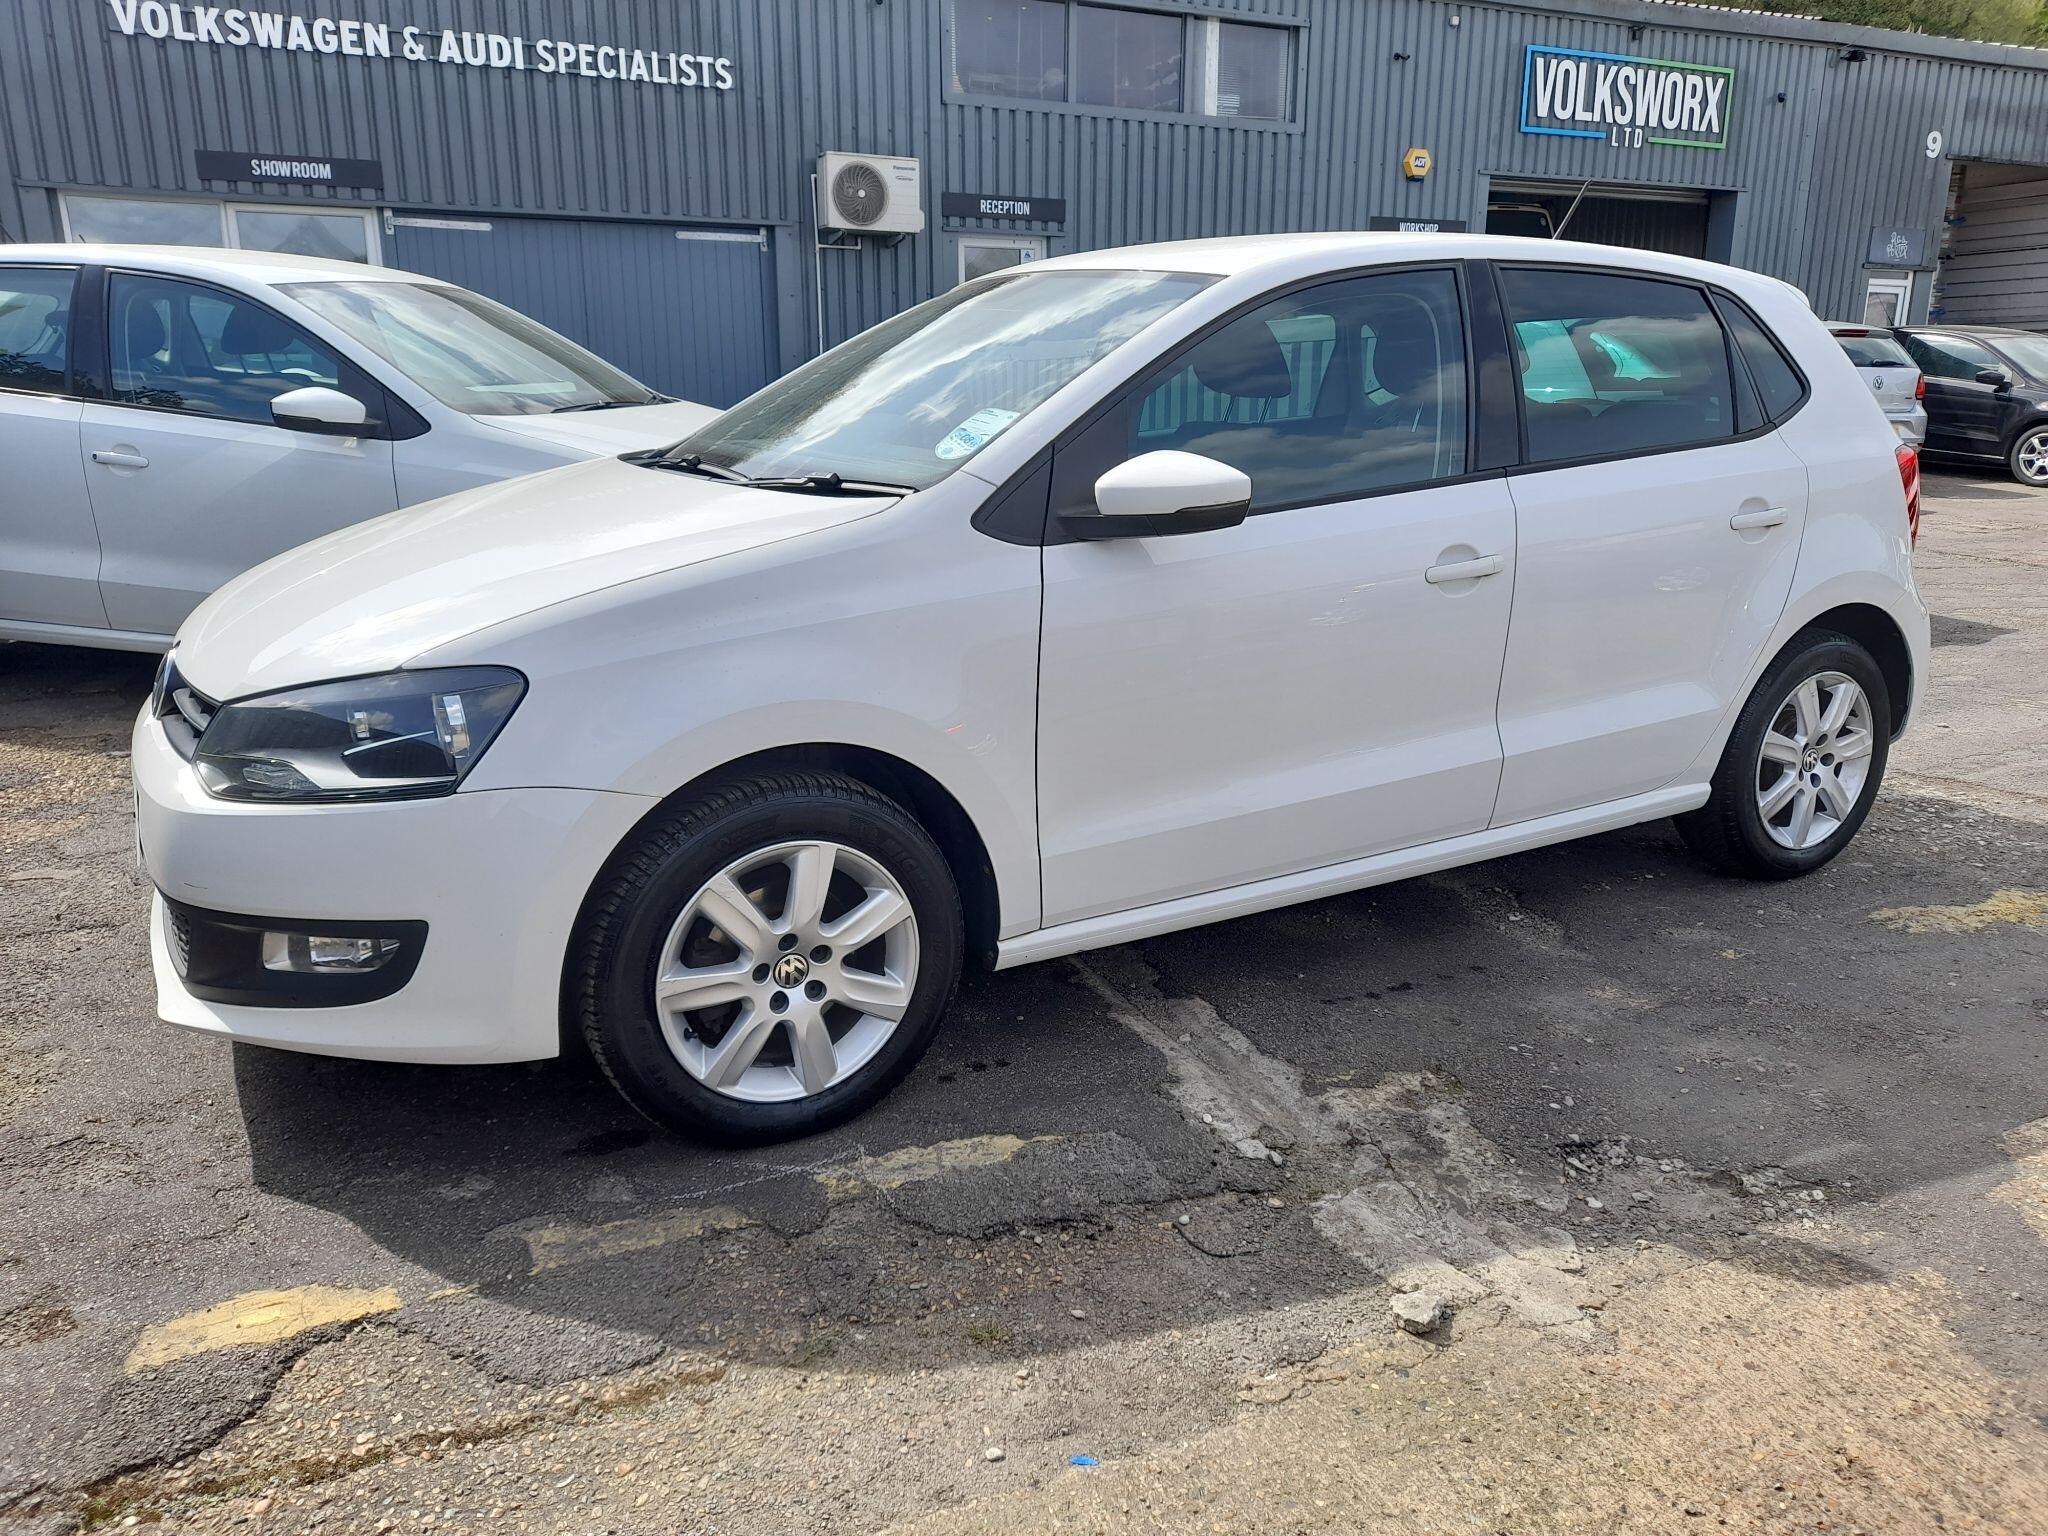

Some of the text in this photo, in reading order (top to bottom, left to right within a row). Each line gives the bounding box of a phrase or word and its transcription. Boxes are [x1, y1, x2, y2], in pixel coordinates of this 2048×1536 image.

[109, 0, 733, 90] VOLKSWAGEN & AUDI SPECIALISTS
[1536, 57, 1725, 134] VOLKSWORX
[1610, 126, 1643, 149] LTD
[1926, 130, 1942, 159] 9
[250, 158, 332, 180] SHOWROOM
[980, 199, 1031, 215] RECEPTION
[1399, 221, 1439, 232] WORKSHOP
